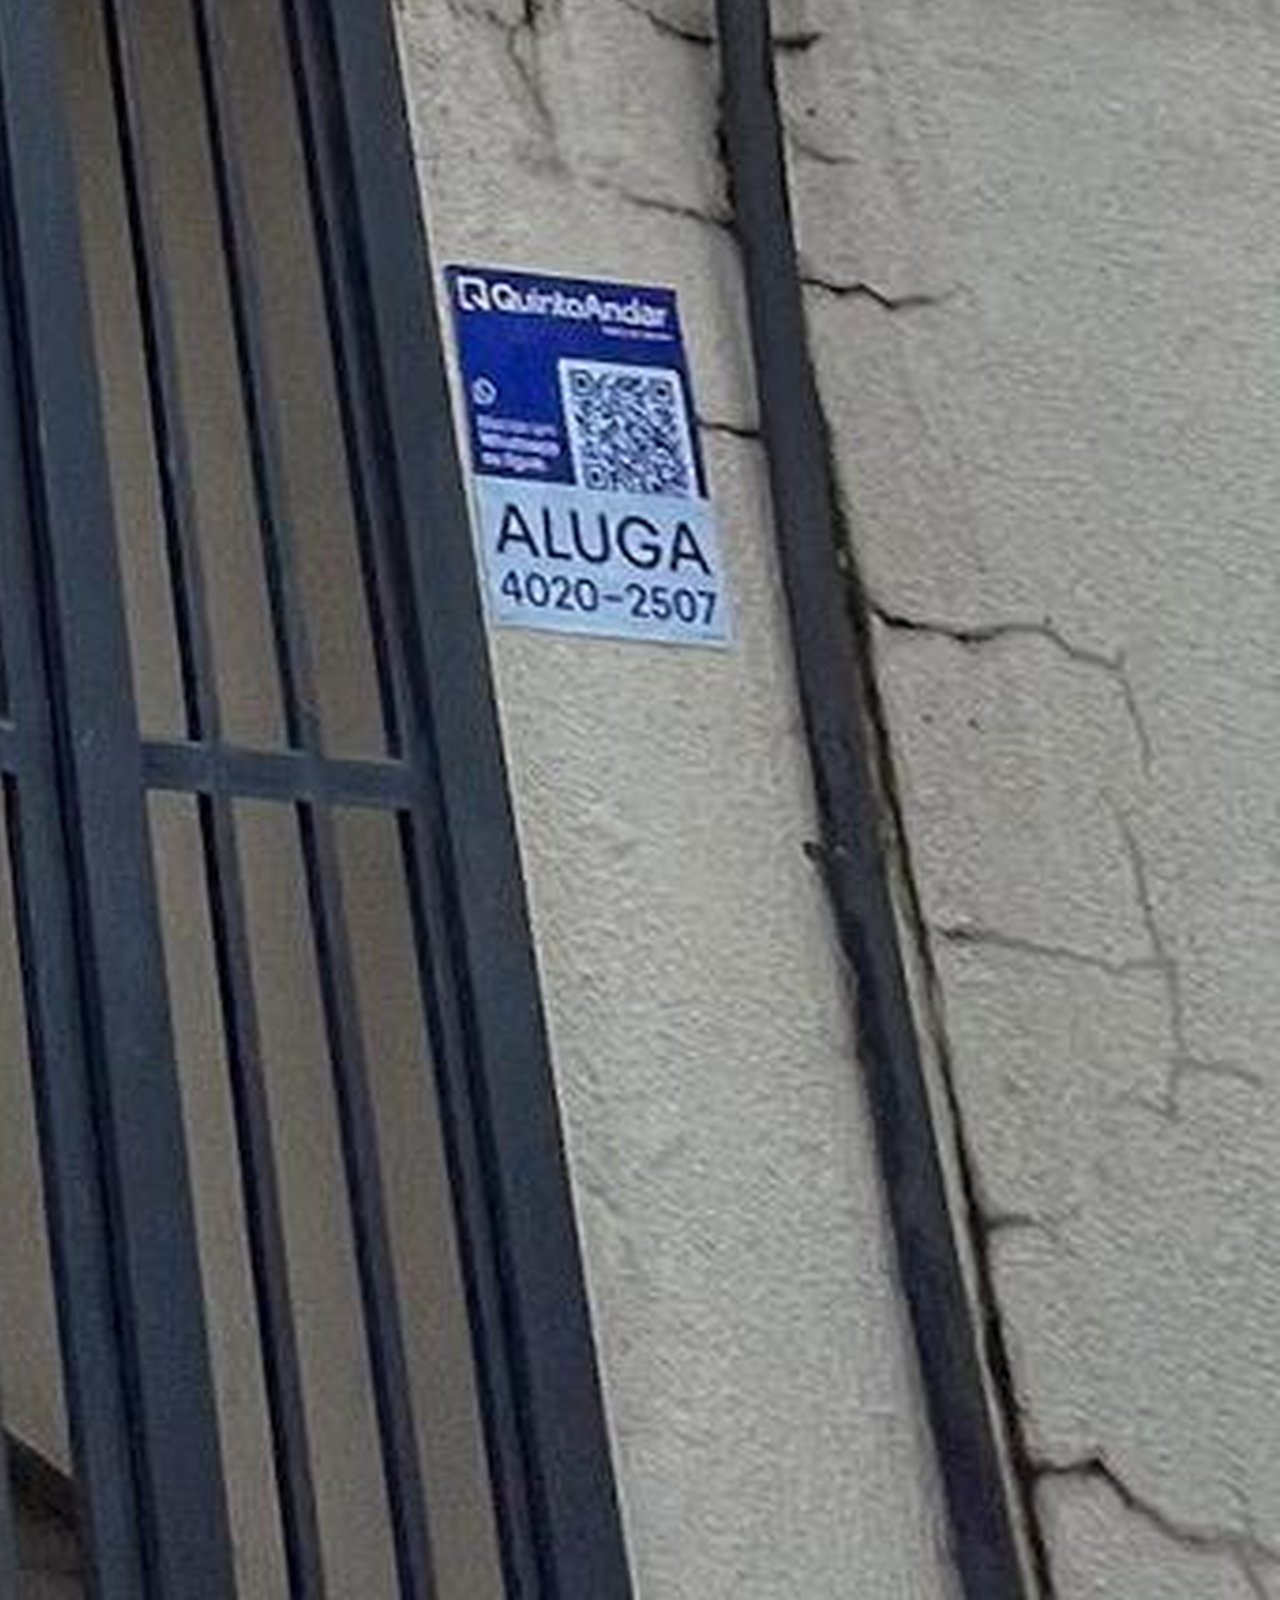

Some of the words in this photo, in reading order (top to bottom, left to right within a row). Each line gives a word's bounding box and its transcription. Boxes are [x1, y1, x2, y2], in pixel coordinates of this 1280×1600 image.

[491, 283, 668, 326] QuintoAndar
[497, 504, 712, 576] ALUGA
[501, 571, 717, 625] 4020-2507
